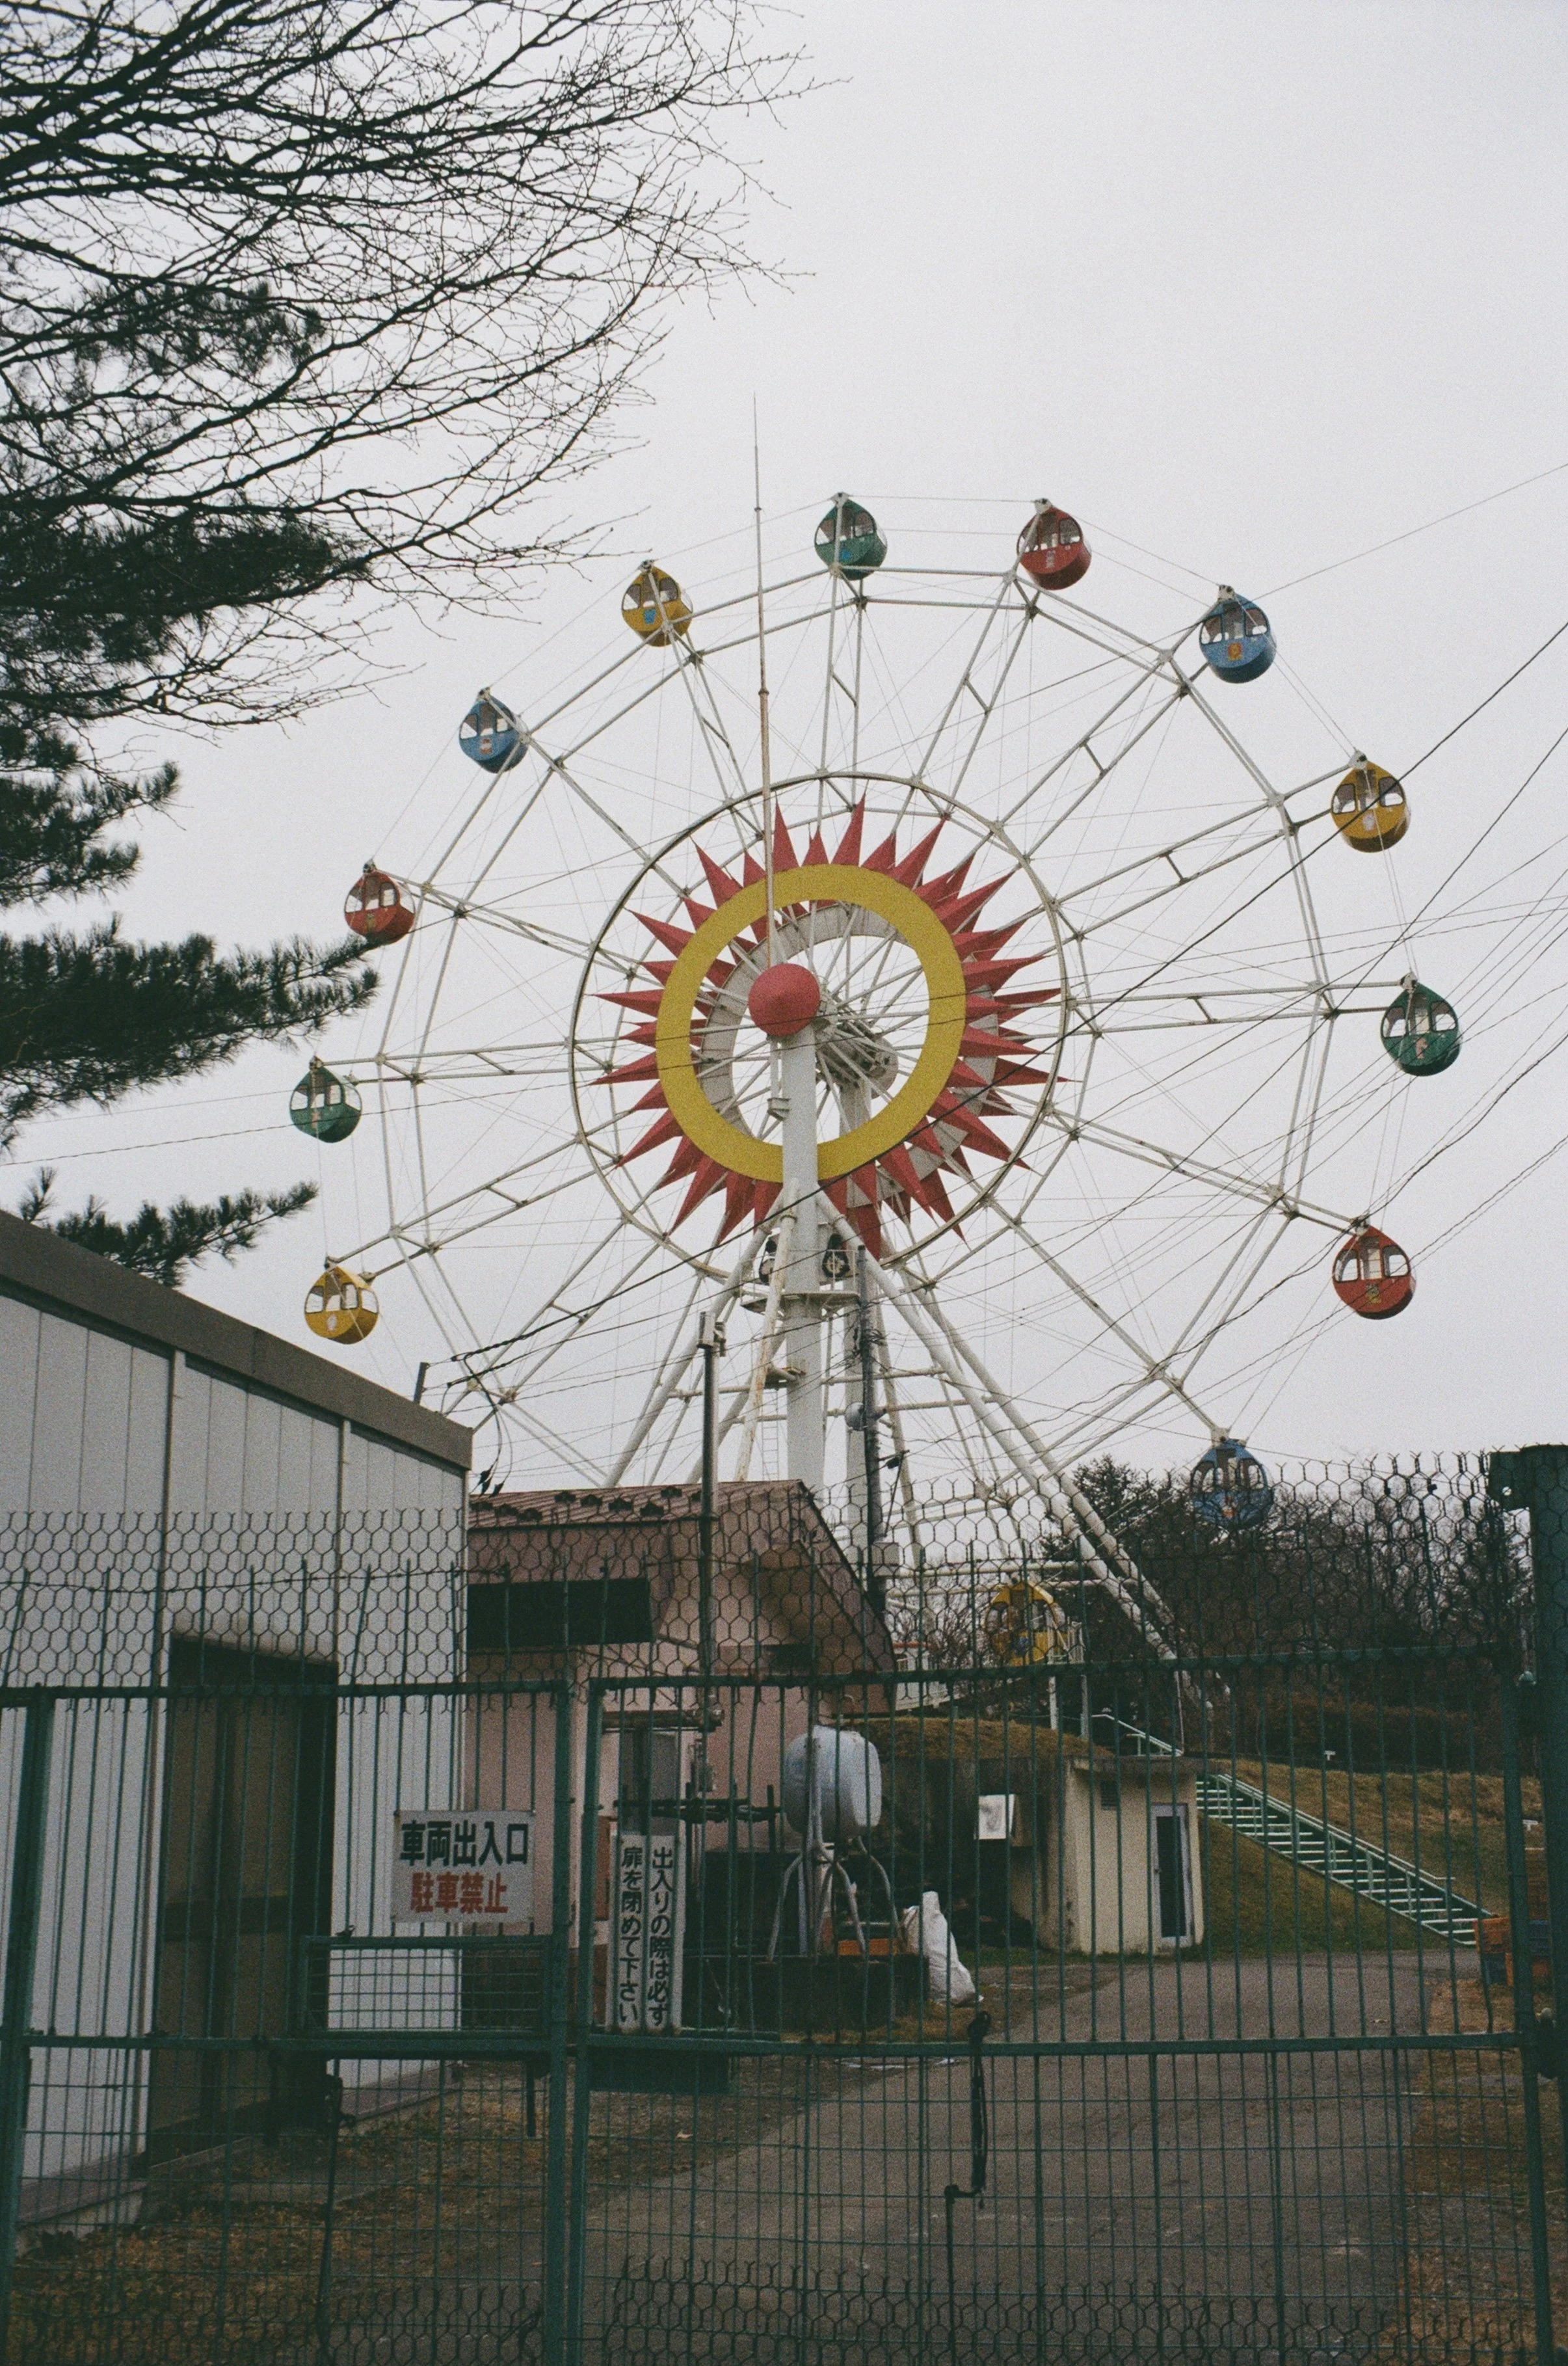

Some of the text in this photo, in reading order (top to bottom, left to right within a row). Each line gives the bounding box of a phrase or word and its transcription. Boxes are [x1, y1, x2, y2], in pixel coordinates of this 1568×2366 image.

[400, 1820, 528, 1866] 車両出入口
[410, 1872, 509, 1913] 駐車禁止
[620, 1847, 643, 2023] 扉を閉めて下さい
